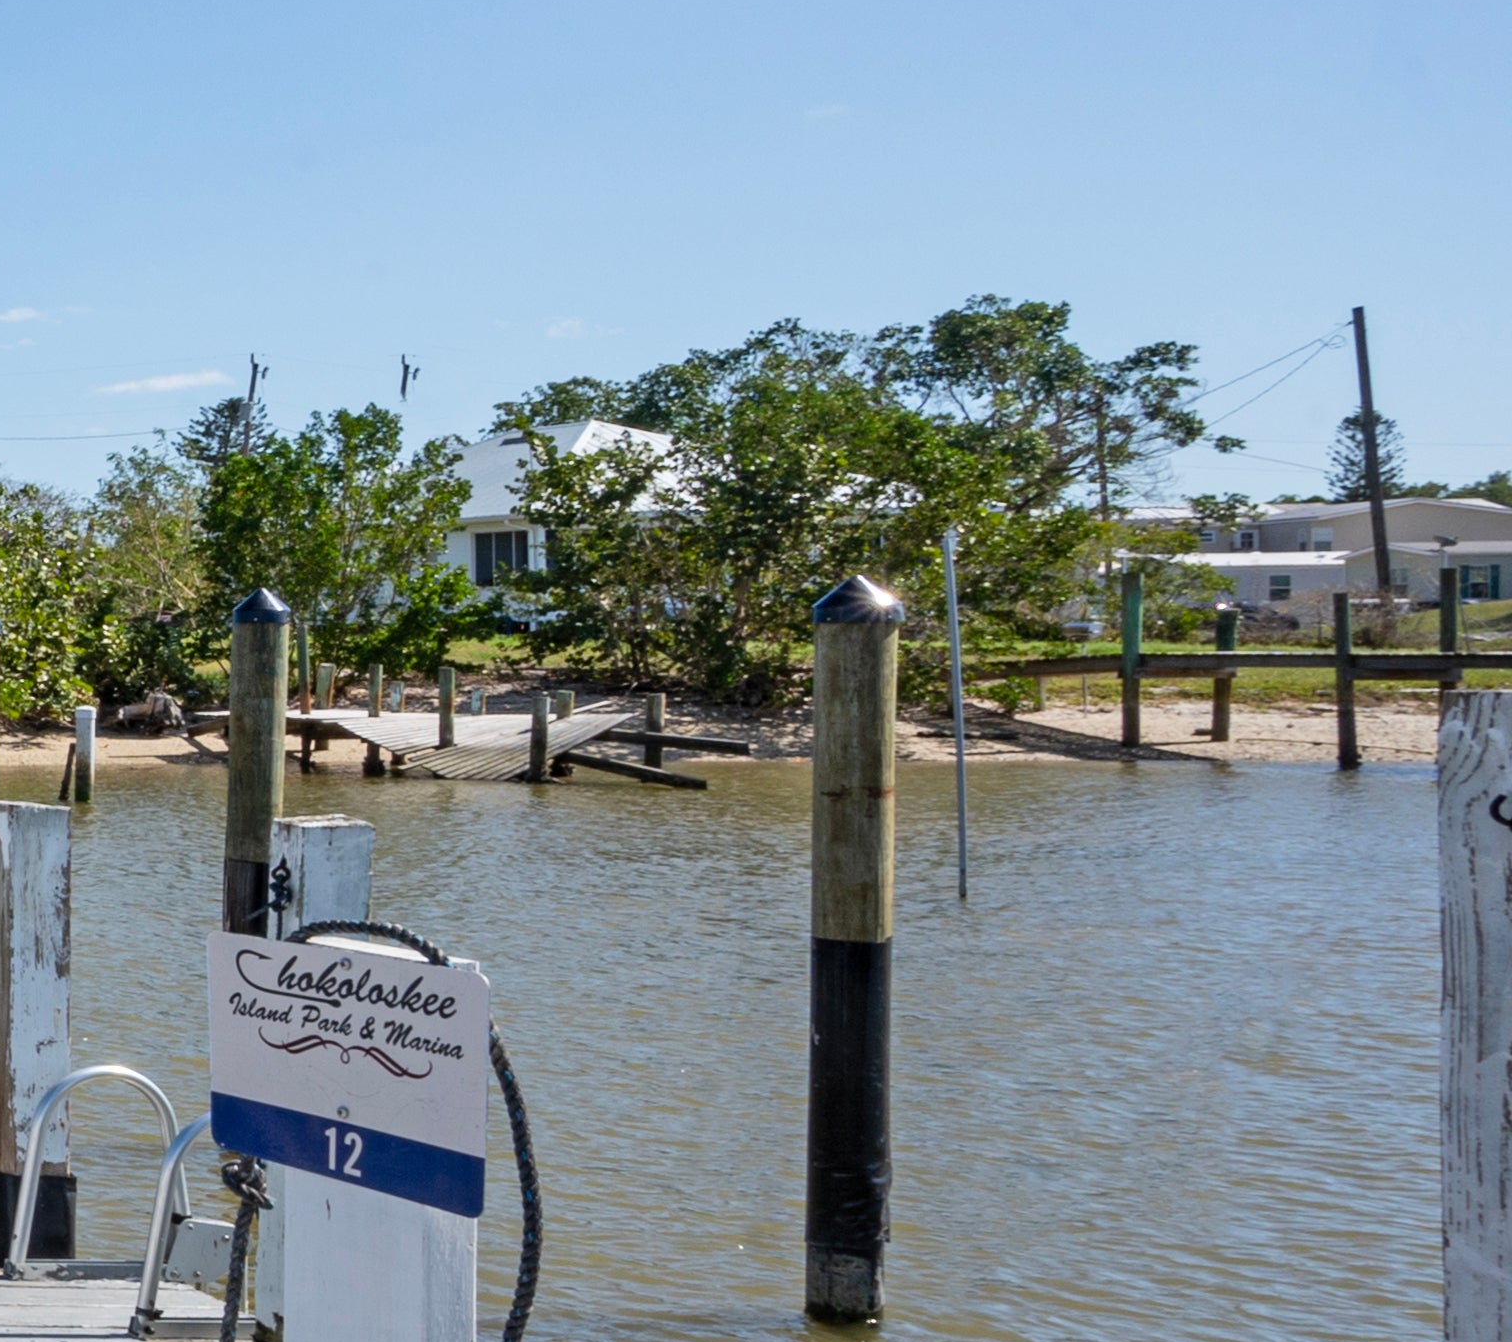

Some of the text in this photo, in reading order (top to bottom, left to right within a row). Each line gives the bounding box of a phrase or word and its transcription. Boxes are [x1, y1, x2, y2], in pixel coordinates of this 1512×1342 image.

[235, 949, 457, 1019] Chokoloskee
[229, 992, 465, 1059] Island Park & Marina
[325, 1126, 363, 1178] 12
